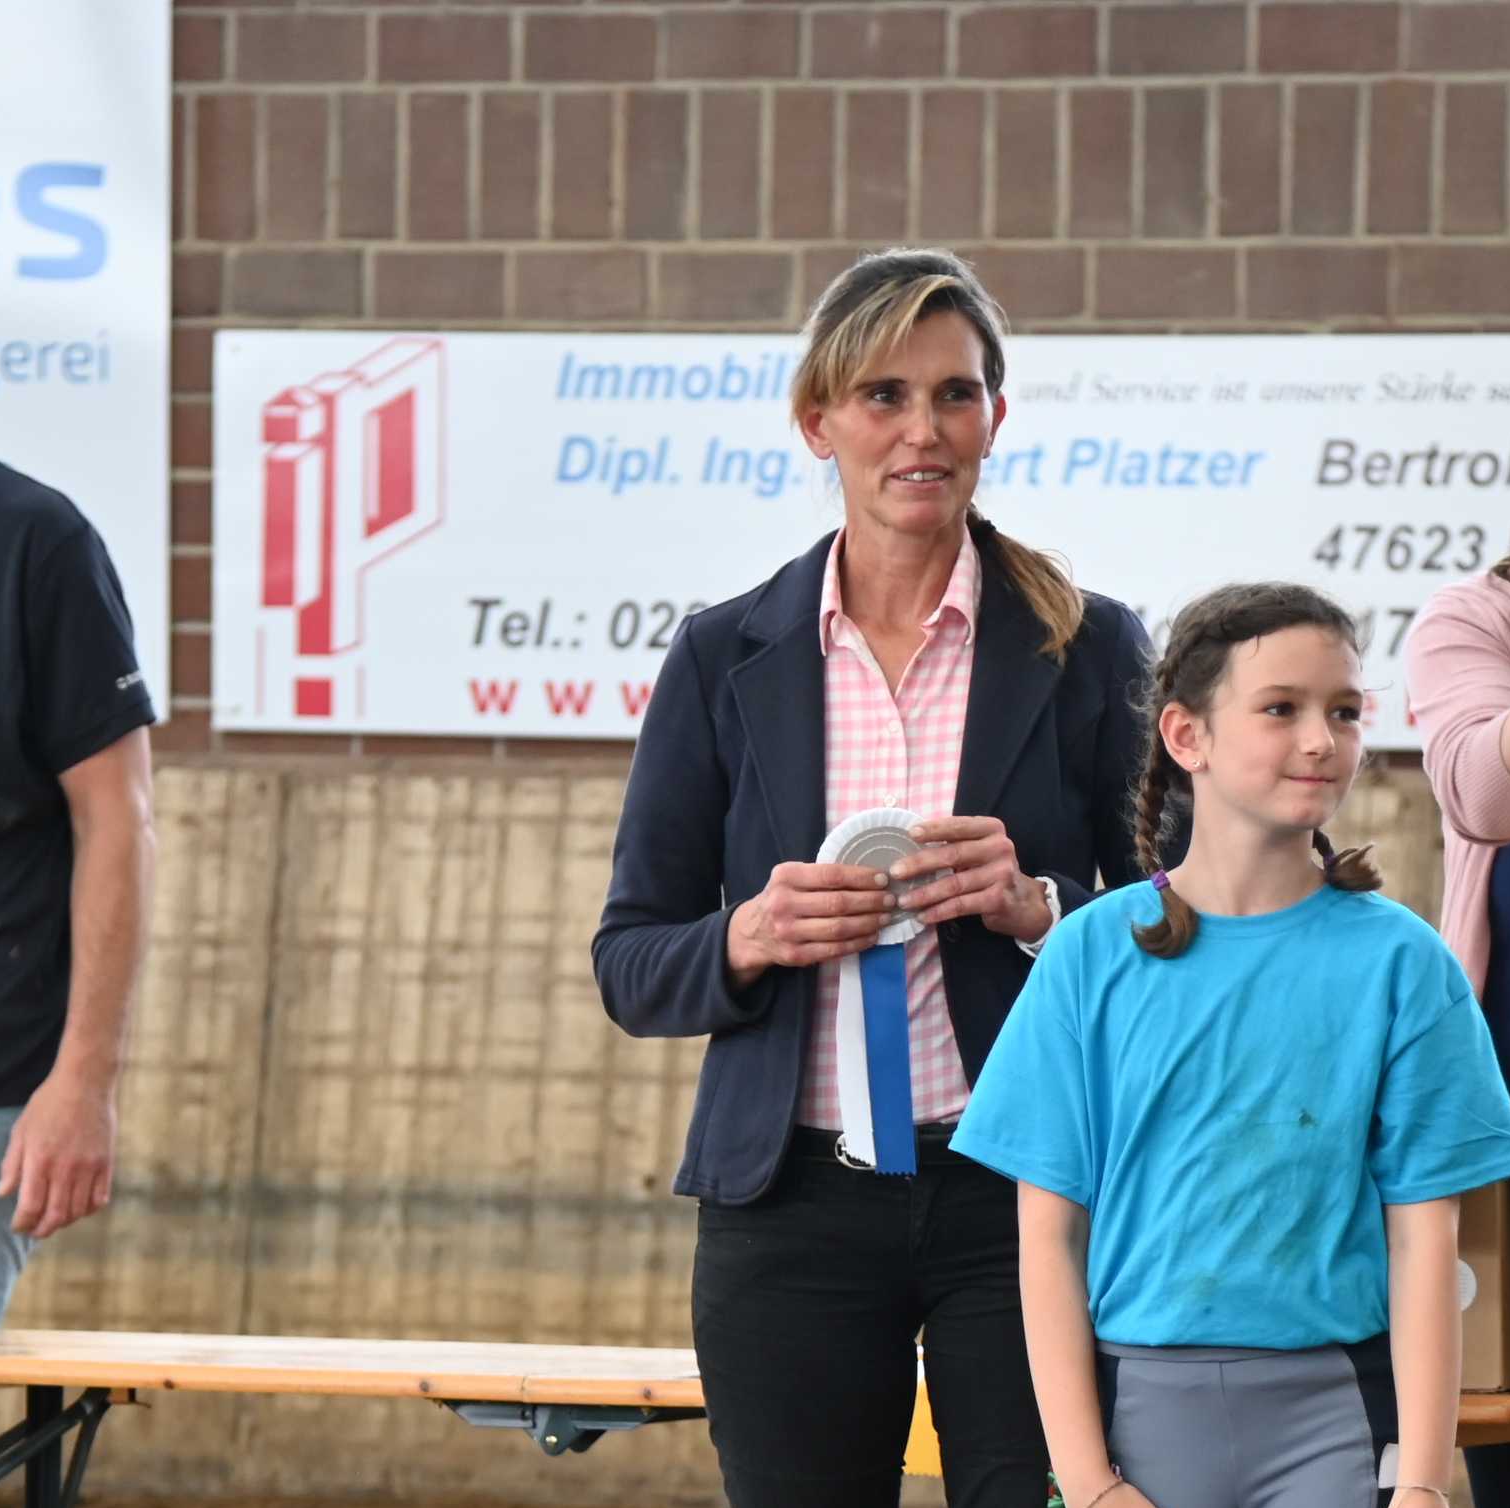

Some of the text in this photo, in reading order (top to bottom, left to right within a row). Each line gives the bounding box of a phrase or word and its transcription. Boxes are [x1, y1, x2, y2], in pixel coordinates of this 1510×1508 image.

[556, 350, 793, 401] Immobil
[1093, 373, 1200, 402] Service
[556, 434, 679, 495] Dipl.
[702, 435, 802, 498] Ing.
[1062, 437, 1267, 487] Platzer
[1313, 524, 1487, 572] 47623
[467, 597, 587, 649] Tel.:
